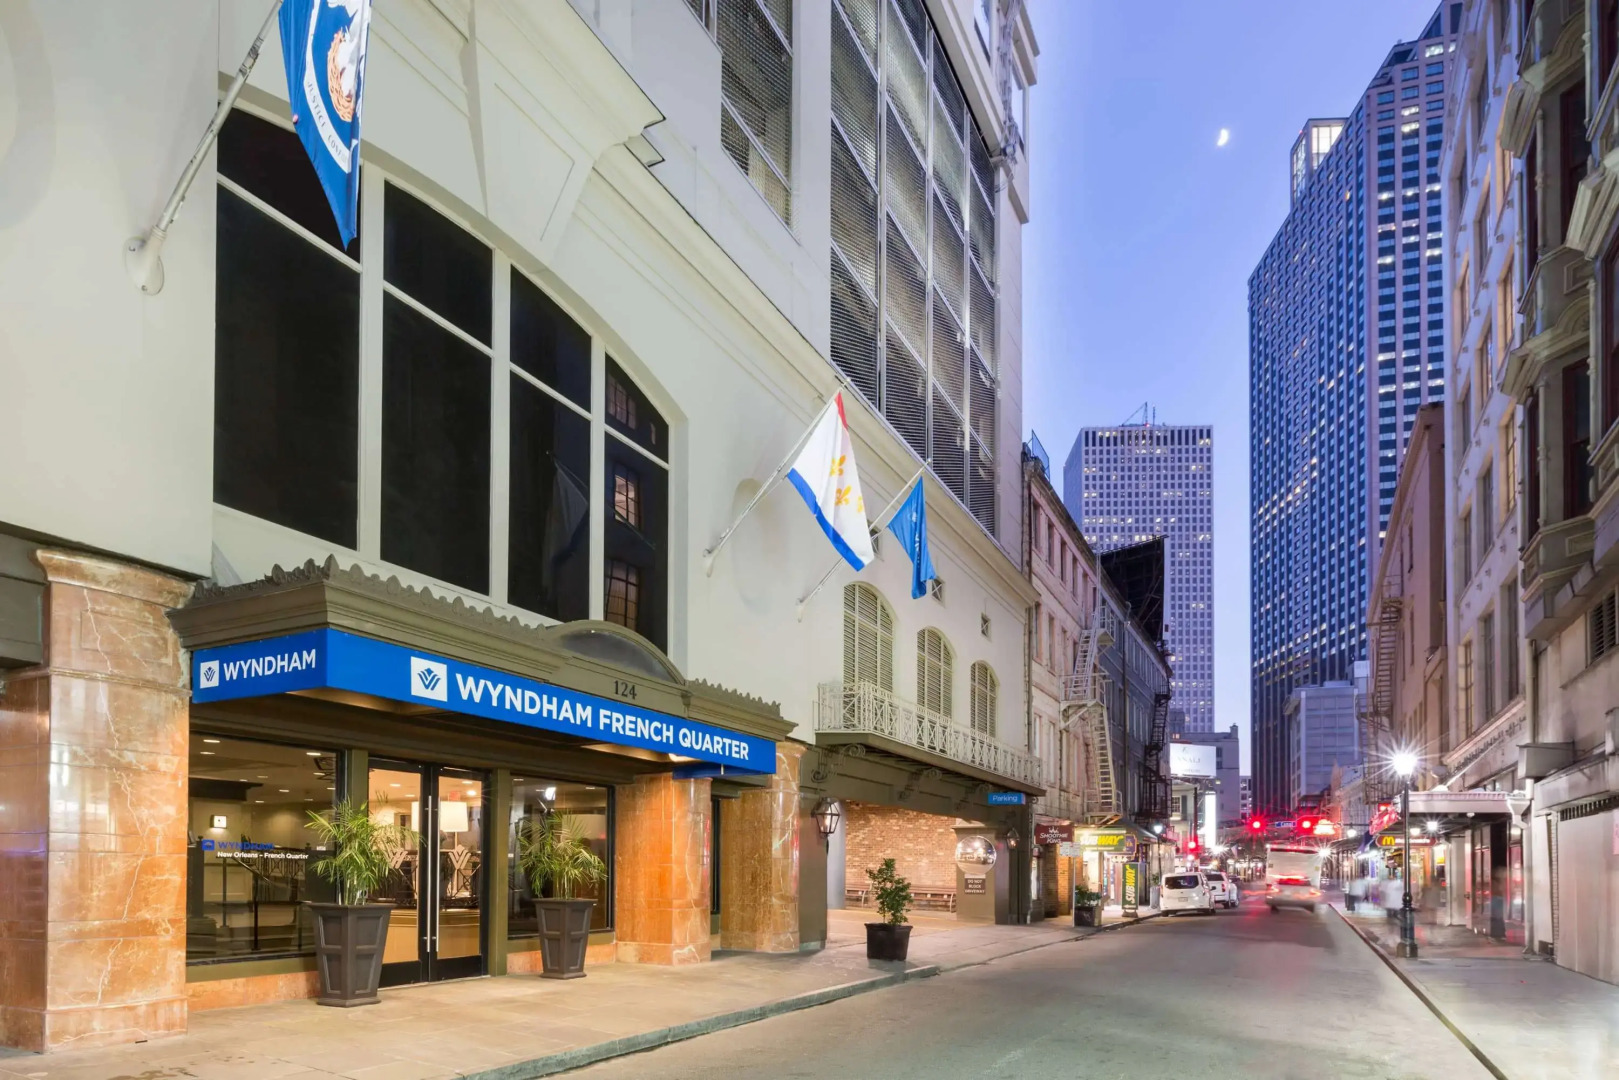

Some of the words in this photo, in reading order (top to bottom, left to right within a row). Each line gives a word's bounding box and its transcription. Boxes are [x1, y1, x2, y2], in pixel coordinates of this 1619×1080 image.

[223, 649, 316, 681] WYNDHAM
[613, 680, 638, 700] 124
[455, 673, 593, 728] WYNDHAM
[599, 709, 674, 745] FRENCH
[678, 727, 750, 761] QUARTER
[992, 794, 1018, 803] Parking
[218, 841, 275, 851] WYNDHAM
[1080, 835, 1124, 846] SUBWAY
[234, 851, 258, 859] Orleans
[1125, 864, 1135, 904] SUBWAY
